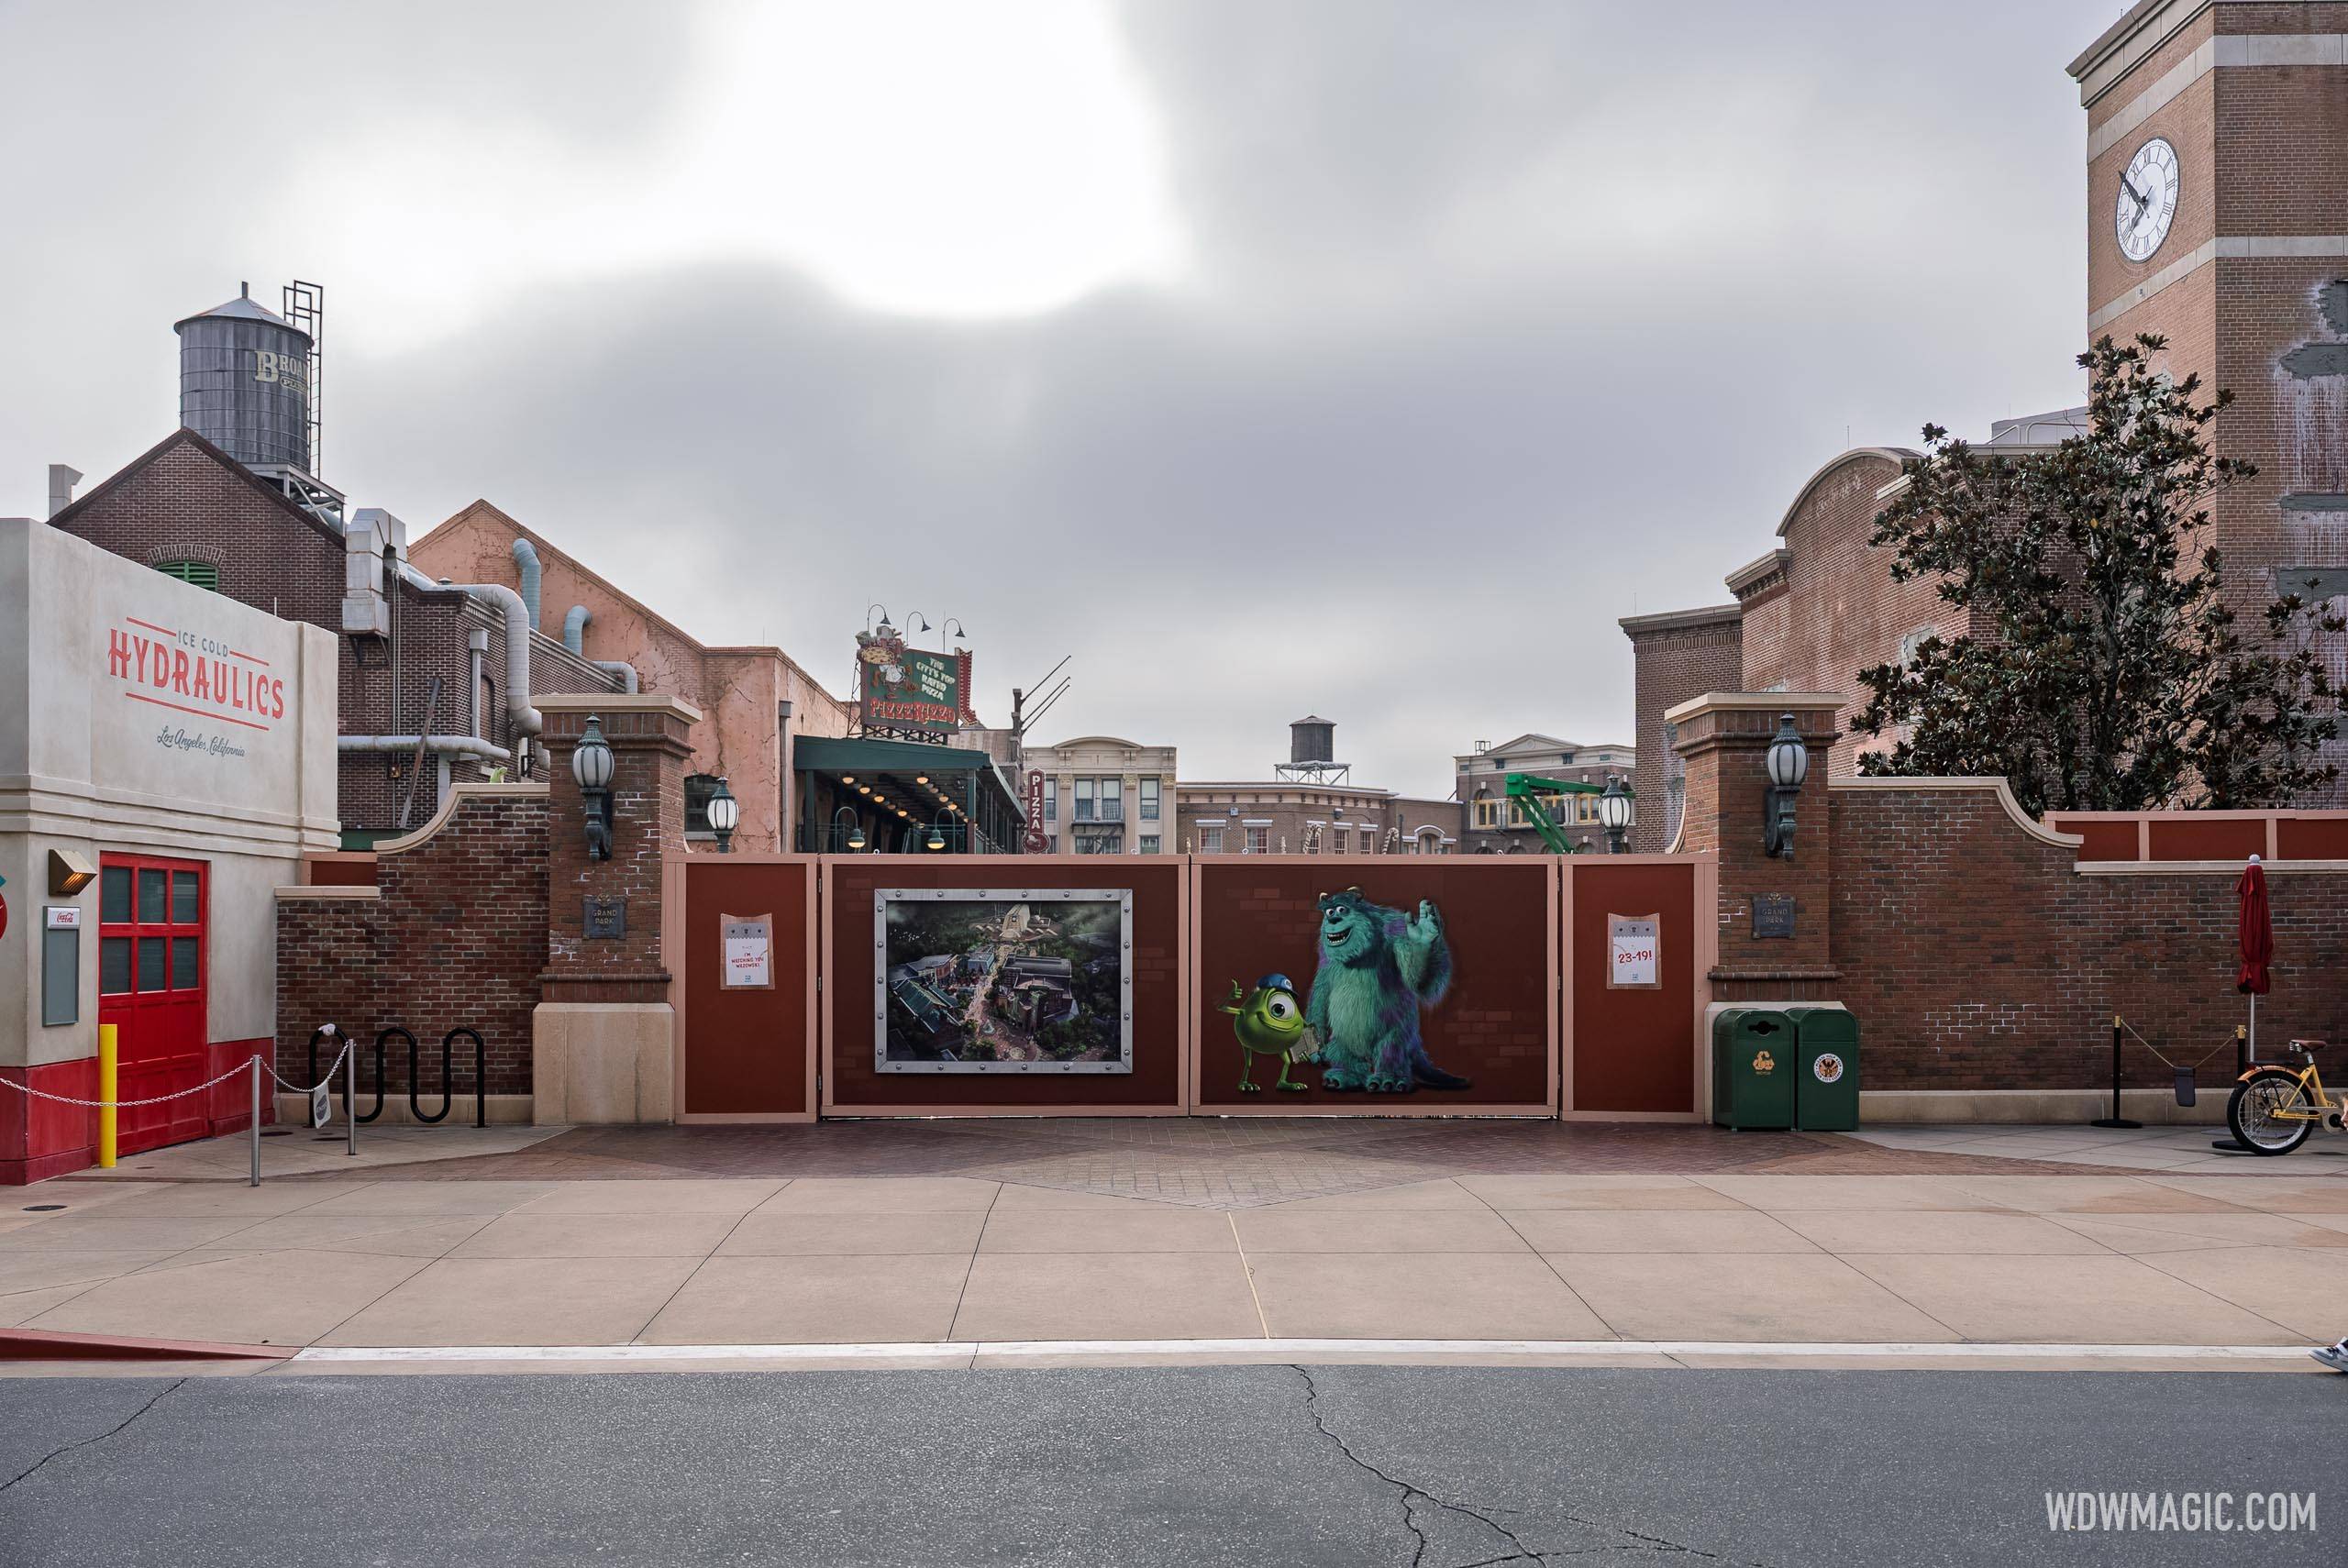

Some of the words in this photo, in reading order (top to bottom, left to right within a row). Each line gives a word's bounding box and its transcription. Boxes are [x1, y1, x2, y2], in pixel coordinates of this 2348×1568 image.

[178, 630, 195, 647] ICE
[202, 637, 228, 657] COLD
[108, 628, 284, 719] HYDRAULICS
[922, 683, 944, 701] PIZZA
[157, 726, 173, 747] Los
[174, 729, 209, 751] Angeles,
[210, 736, 246, 757] California
[1031, 775, 1041, 830] PIZZA
[1618, 950, 1653, 964] 23-19!
